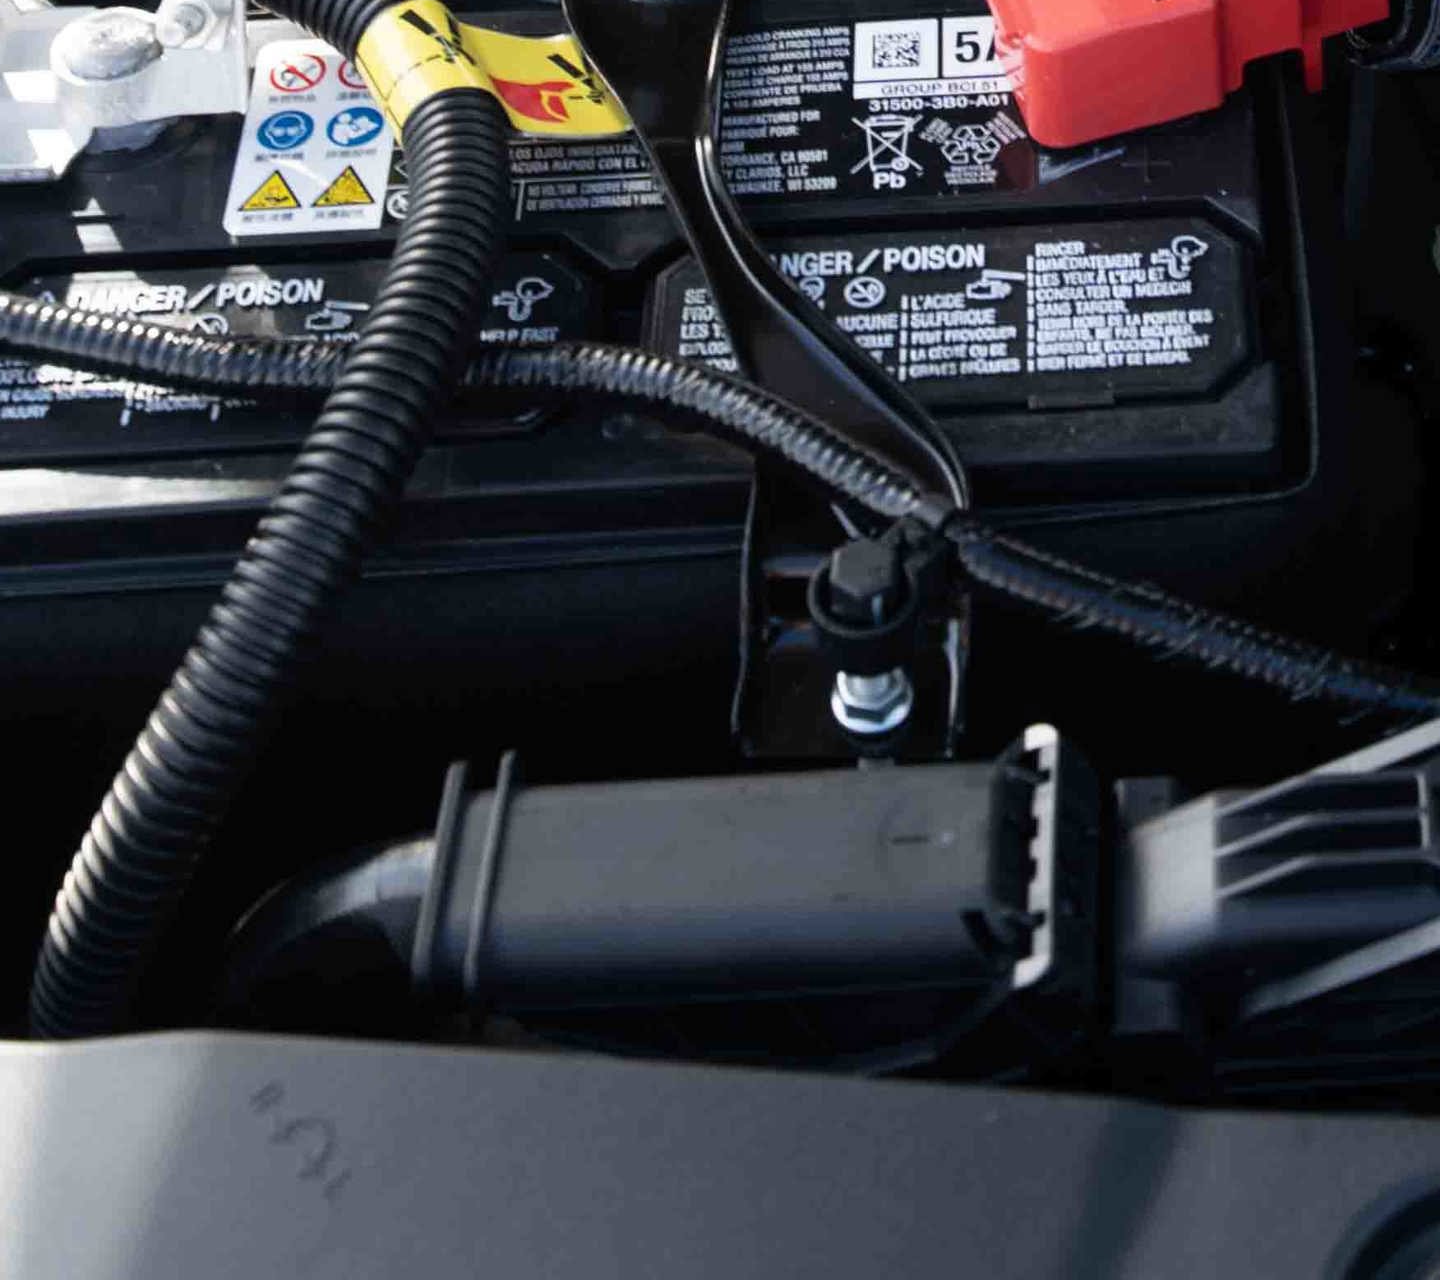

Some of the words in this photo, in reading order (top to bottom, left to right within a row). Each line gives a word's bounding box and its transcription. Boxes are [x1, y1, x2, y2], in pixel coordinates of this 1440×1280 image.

[745, 32, 771, 43] COLD
[772, 27, 821, 41] CRANKING
[822, 26, 850, 37] AMPS
[726, 69, 750, 79] TEST
[752, 65, 780, 77] LOAD
[781, 63, 794, 74] AT
[815, 61, 845, 72] AMPS
[766, 74, 804, 85] CHARGE
[822, 71, 849, 82] AMPS
[783, 85, 798, 95] DE
[799, 82, 843, 93] PRUEBA
[881, 81, 942, 95] GROUP
[948, 82, 978, 93] BCI
[868, 94, 1010, 112] 31500-3B0-A01
[722, 112, 799, 127] MANUFACTURED
[800, 110, 821, 122] FOR
[597, 157, 622, 170] CON
[624, 157, 639, 169] EL
[780, 151, 796, 164] CA
[787, 164, 810, 177] LLC
[786, 178, 803, 191] WI
[872, 172, 907, 190] Pb
[1035, 241, 1085, 258] RINCER
[1036, 272, 1061, 288] LES
[1062, 271, 1096, 286] YEUX
[1108, 269, 1146, 284] L'EAU
[1148, 267, 1166, 282] ET
[1036, 285, 1111, 302] CONSULTER
[1112, 284, 1132, 299] UN
[911, 293, 966, 311] L'ACIDE
[1036, 301, 1072, 317] SANS
[911, 308, 996, 328] SULFURIQUE
[1037, 316, 1072, 331] TENIR
[1072, 314, 1106, 329] HORS
[1107, 313, 1124, 327] DE
[1125, 313, 1141, 326] LA
[1188, 308, 1213, 324] DES
[681, 323, 709, 339] LES
[911, 330, 943, 345] PEUT
[944, 326, 1017, 342] PROVOQUER
[1095, 326, 1113, 340] NE
[1114, 326, 1138, 339] PAS
[911, 348, 927, 362] LA
[969, 344, 988, 358] OU
[990, 343, 1007, 356] DE
[1036, 341, 1085, 357] GARDER
[1086, 340, 1102, 354] LE
[1103, 338, 1160, 353] BOUCHON
[910, 362, 957, 378] GRAVES
[1037, 355, 1066, 371] BIEN
[1107, 352, 1124, 366] ET
[0, 404, 51, 420] INJURY
